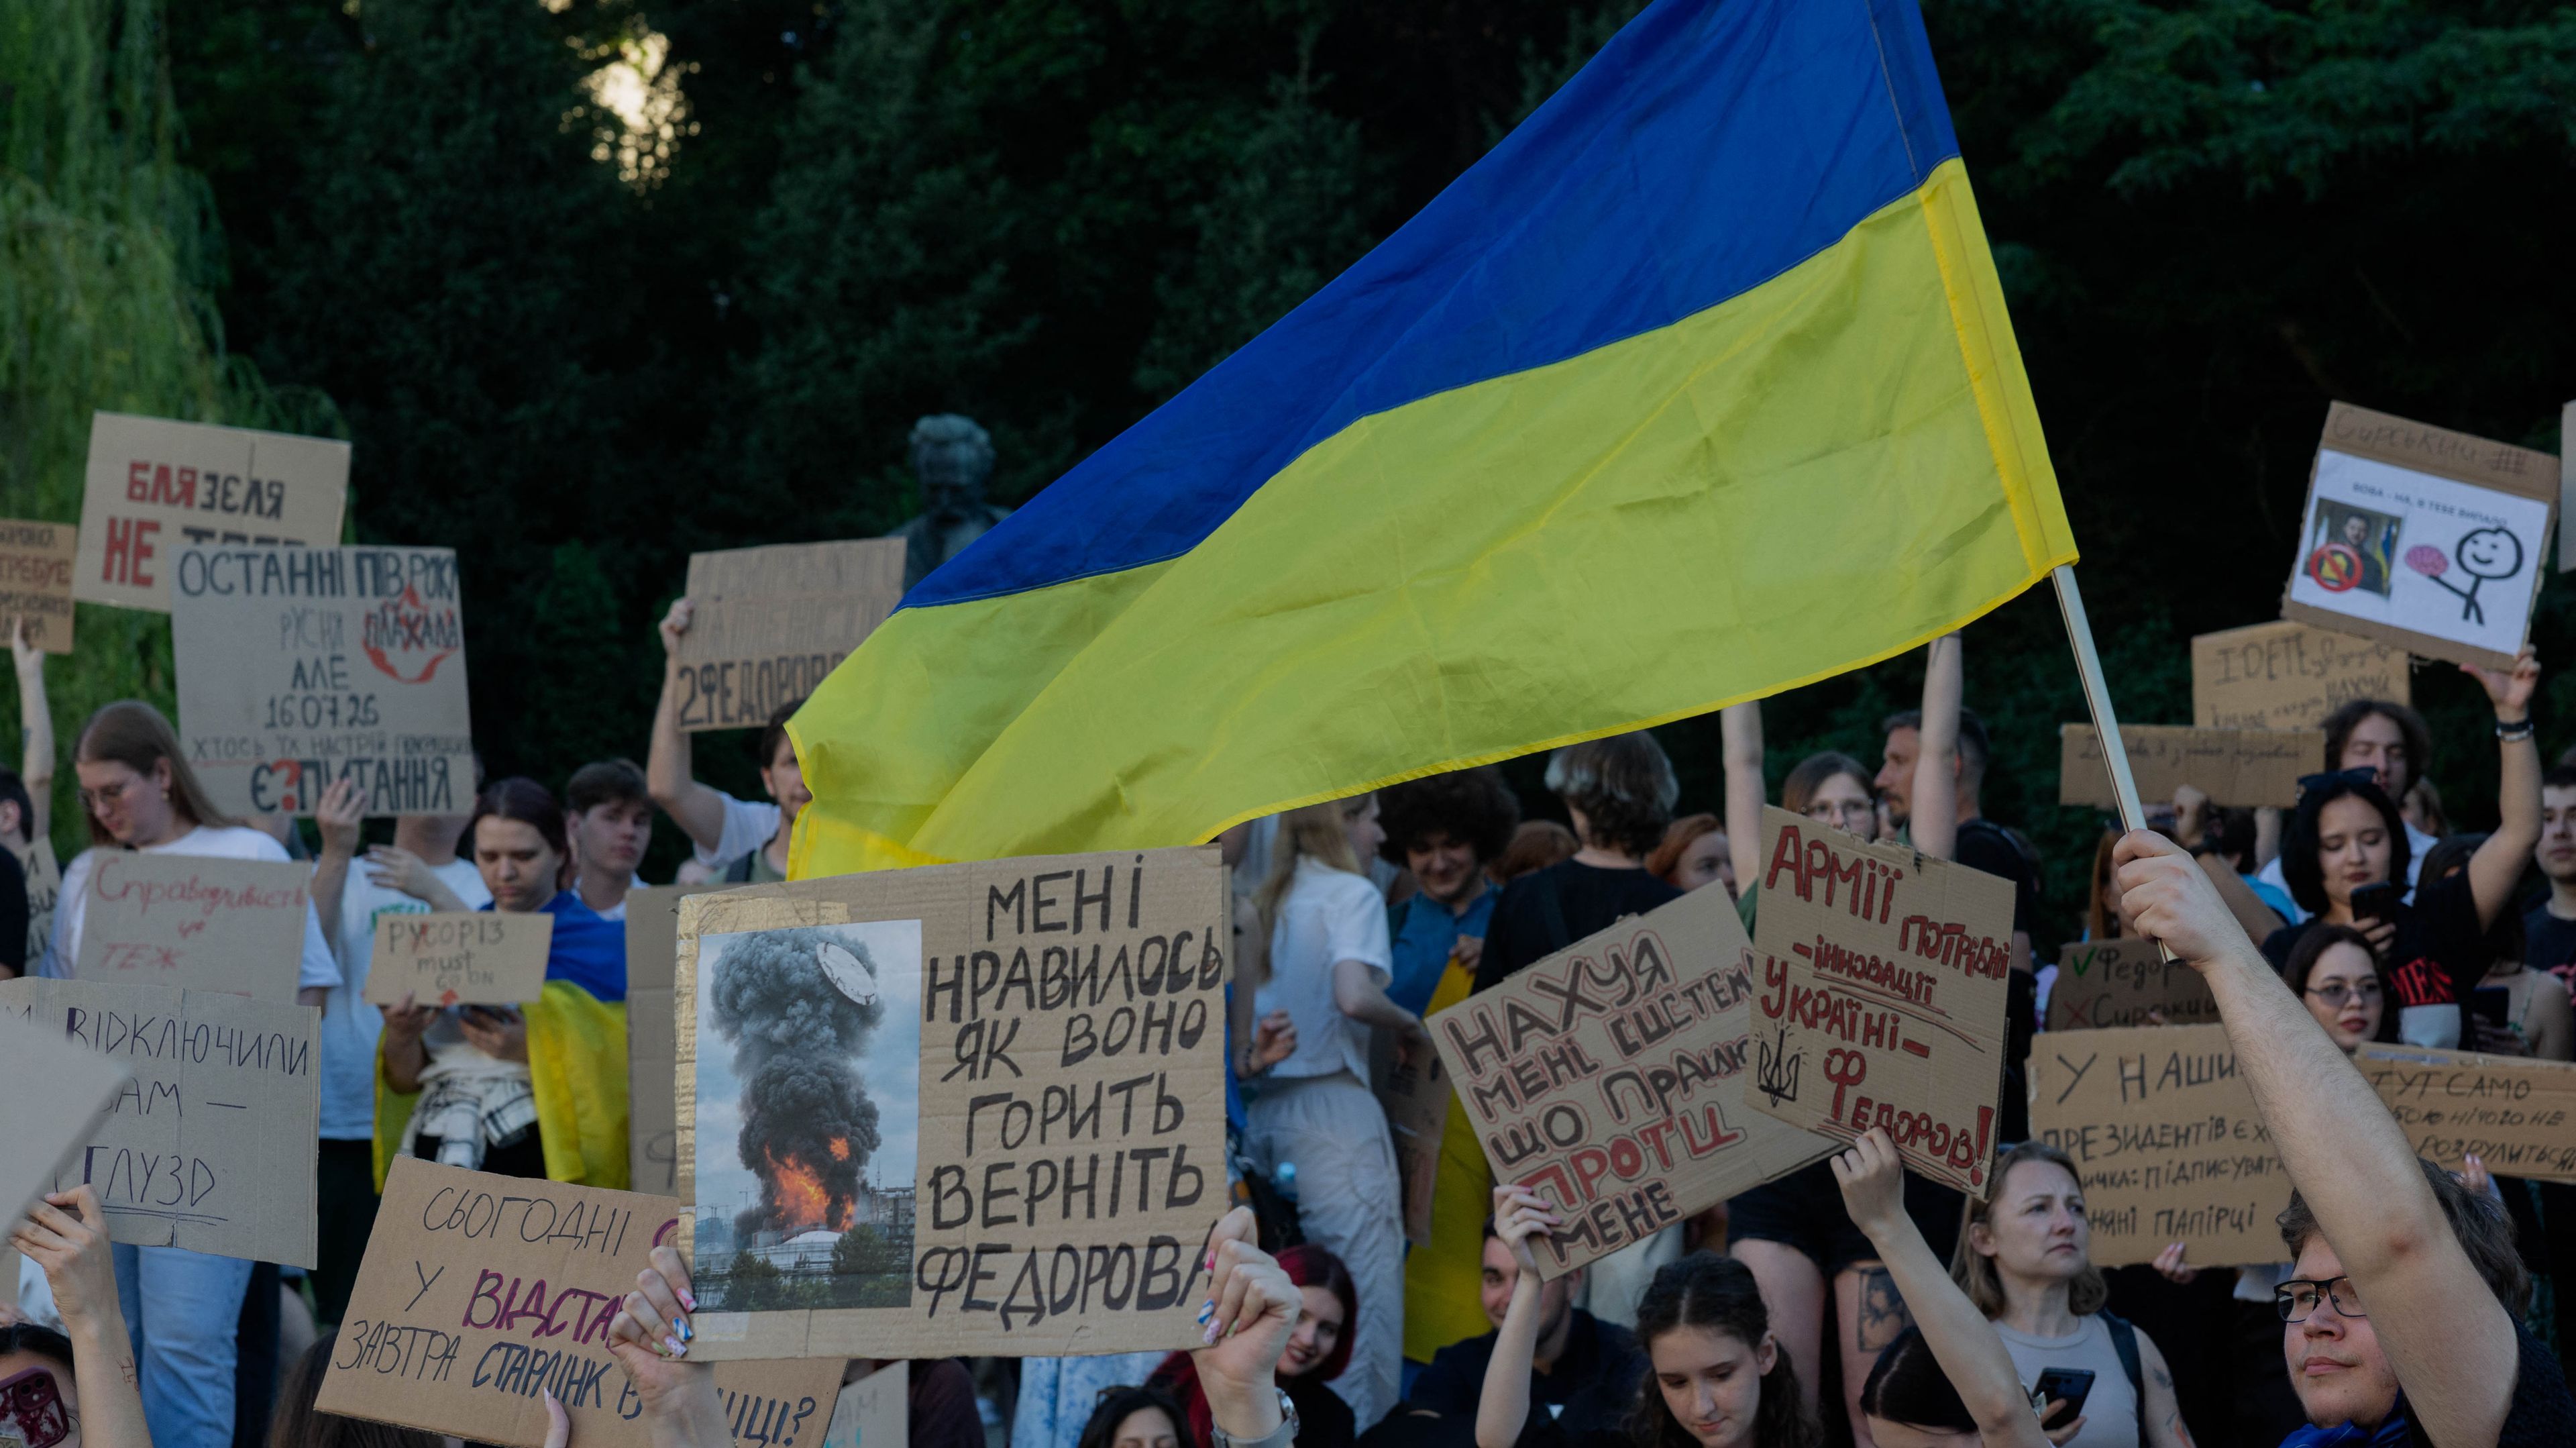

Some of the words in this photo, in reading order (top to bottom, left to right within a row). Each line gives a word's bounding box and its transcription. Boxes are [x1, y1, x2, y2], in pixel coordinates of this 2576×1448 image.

[103, 517, 160, 586] НЕ
[178, 548, 344, 599] ОСТАННІ
[291, 653, 351, 691] АЛЕ
[99, 941, 188, 972] ТЕЖ
[416, 948, 476, 973] must
[926, 927, 1223, 1025] НРАВИЛОСЬ
[1445, 935, 1673, 1076] НАХУЯ
[941, 1016, 1024, 1082] ЯК
[1061, 998, 1208, 1068] ВОНО
[101, 1076, 183, 1117] АМ
[2055, 1051, 2099, 1106] У
[2118, 1050, 2243, 1104] НАШИ
[2446, 1071, 2532, 1100] САМО
[965, 1072, 1185, 1159] ГОРИТЬ
[1489, 1104, 1585, 1166] ЩО
[2530, 1109, 2567, 1127] НЕ
[83, 1145, 216, 1208] ГЛУЗД
[927, 1143, 1205, 1232] ВЕРНІТЬ
[423, 1186, 631, 1257] СЬОГОДНІ
[1550, 1181, 1680, 1264] МЕНЕ
[2153, 1201, 2257, 1237] ПАПІРЦІ
[404, 1260, 445, 1312] У
[335, 1318, 463, 1382] ЗАВТРА
[472, 1341, 612, 1409] СТАРЛІНК
